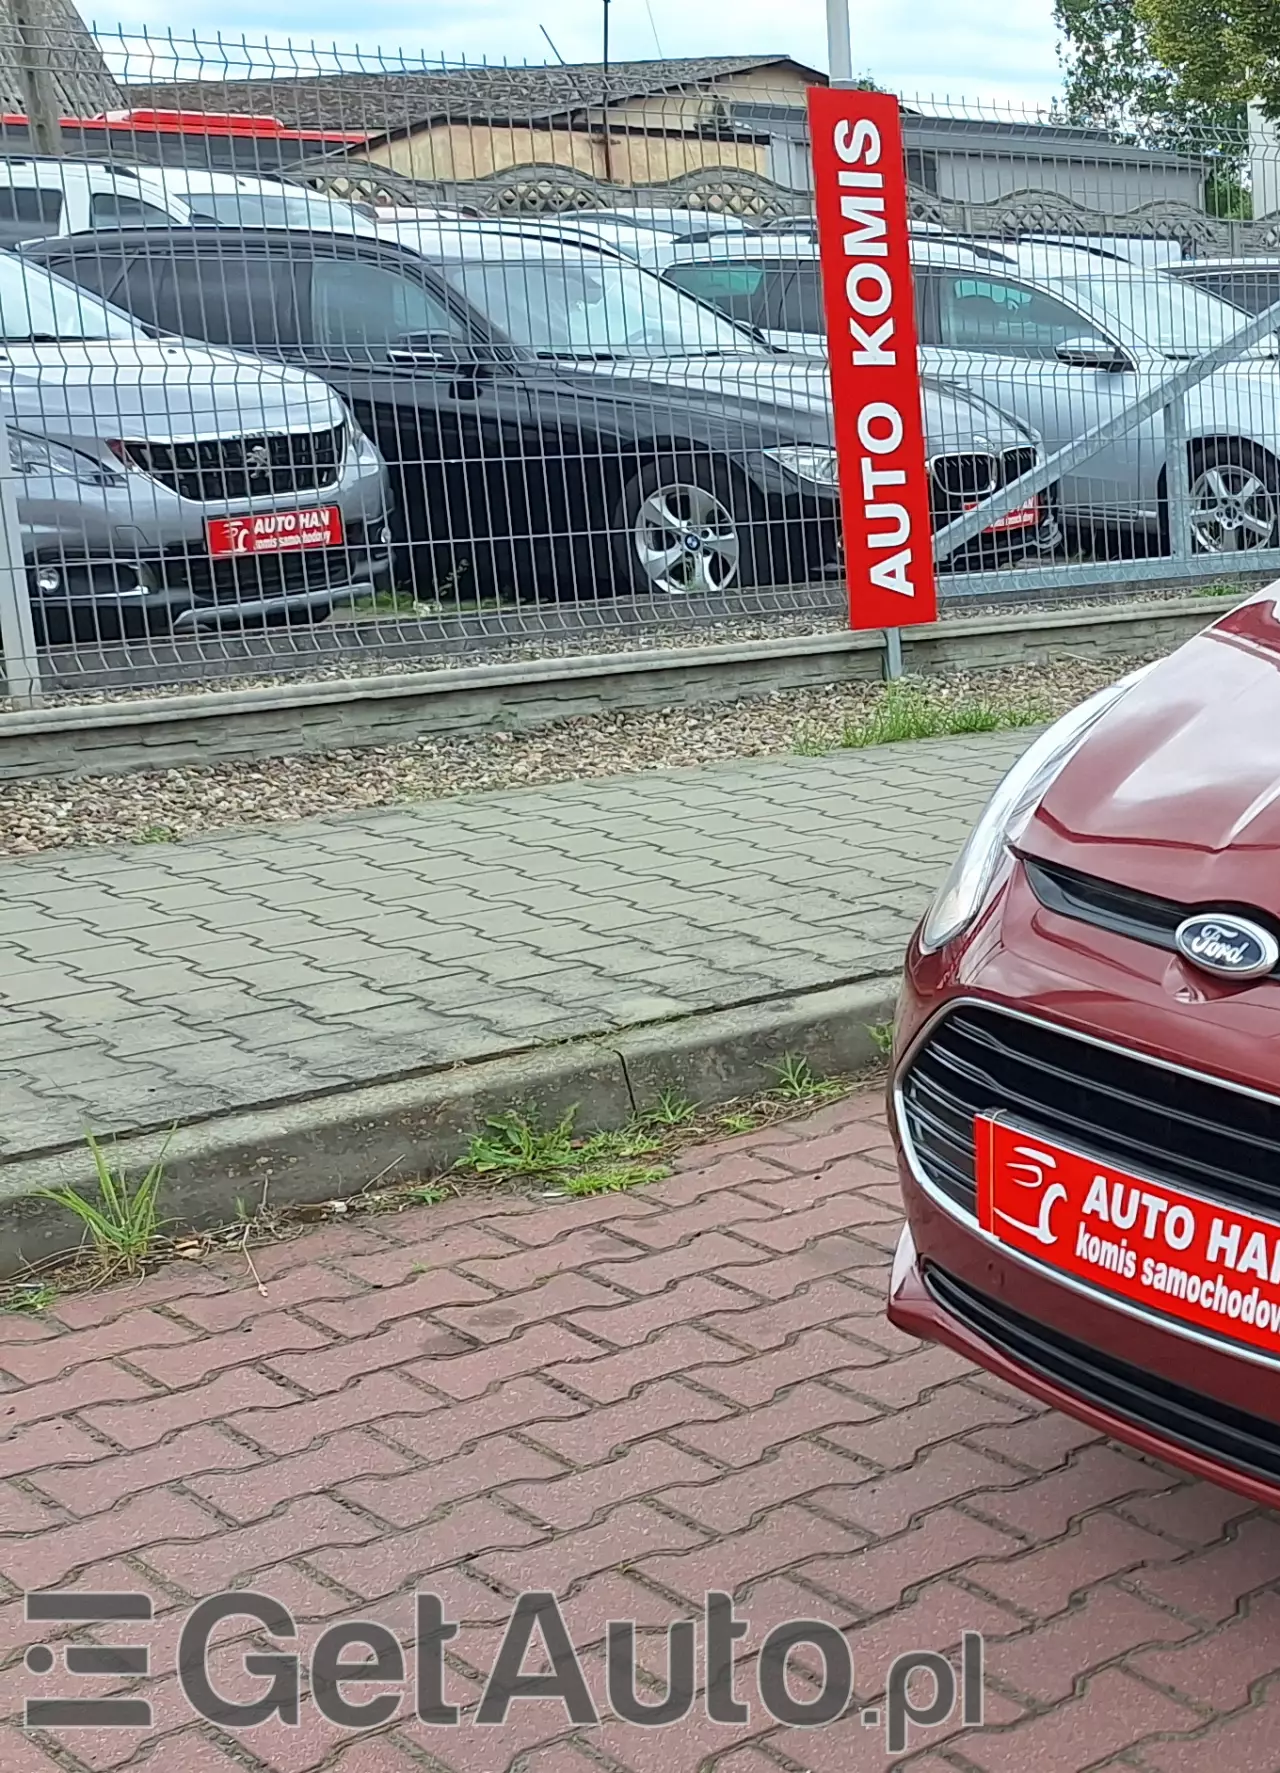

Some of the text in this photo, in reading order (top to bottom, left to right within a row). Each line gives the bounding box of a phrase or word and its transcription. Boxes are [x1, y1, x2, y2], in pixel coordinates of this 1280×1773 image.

[834, 117, 916, 598] AUTO KOMIS
[254, 509, 330, 535] AUTO HAN
[1191, 924, 1250, 964] Ford
[1081, 1174, 1195, 1251] AUTO
[1075, 1222, 1137, 1279] komis
